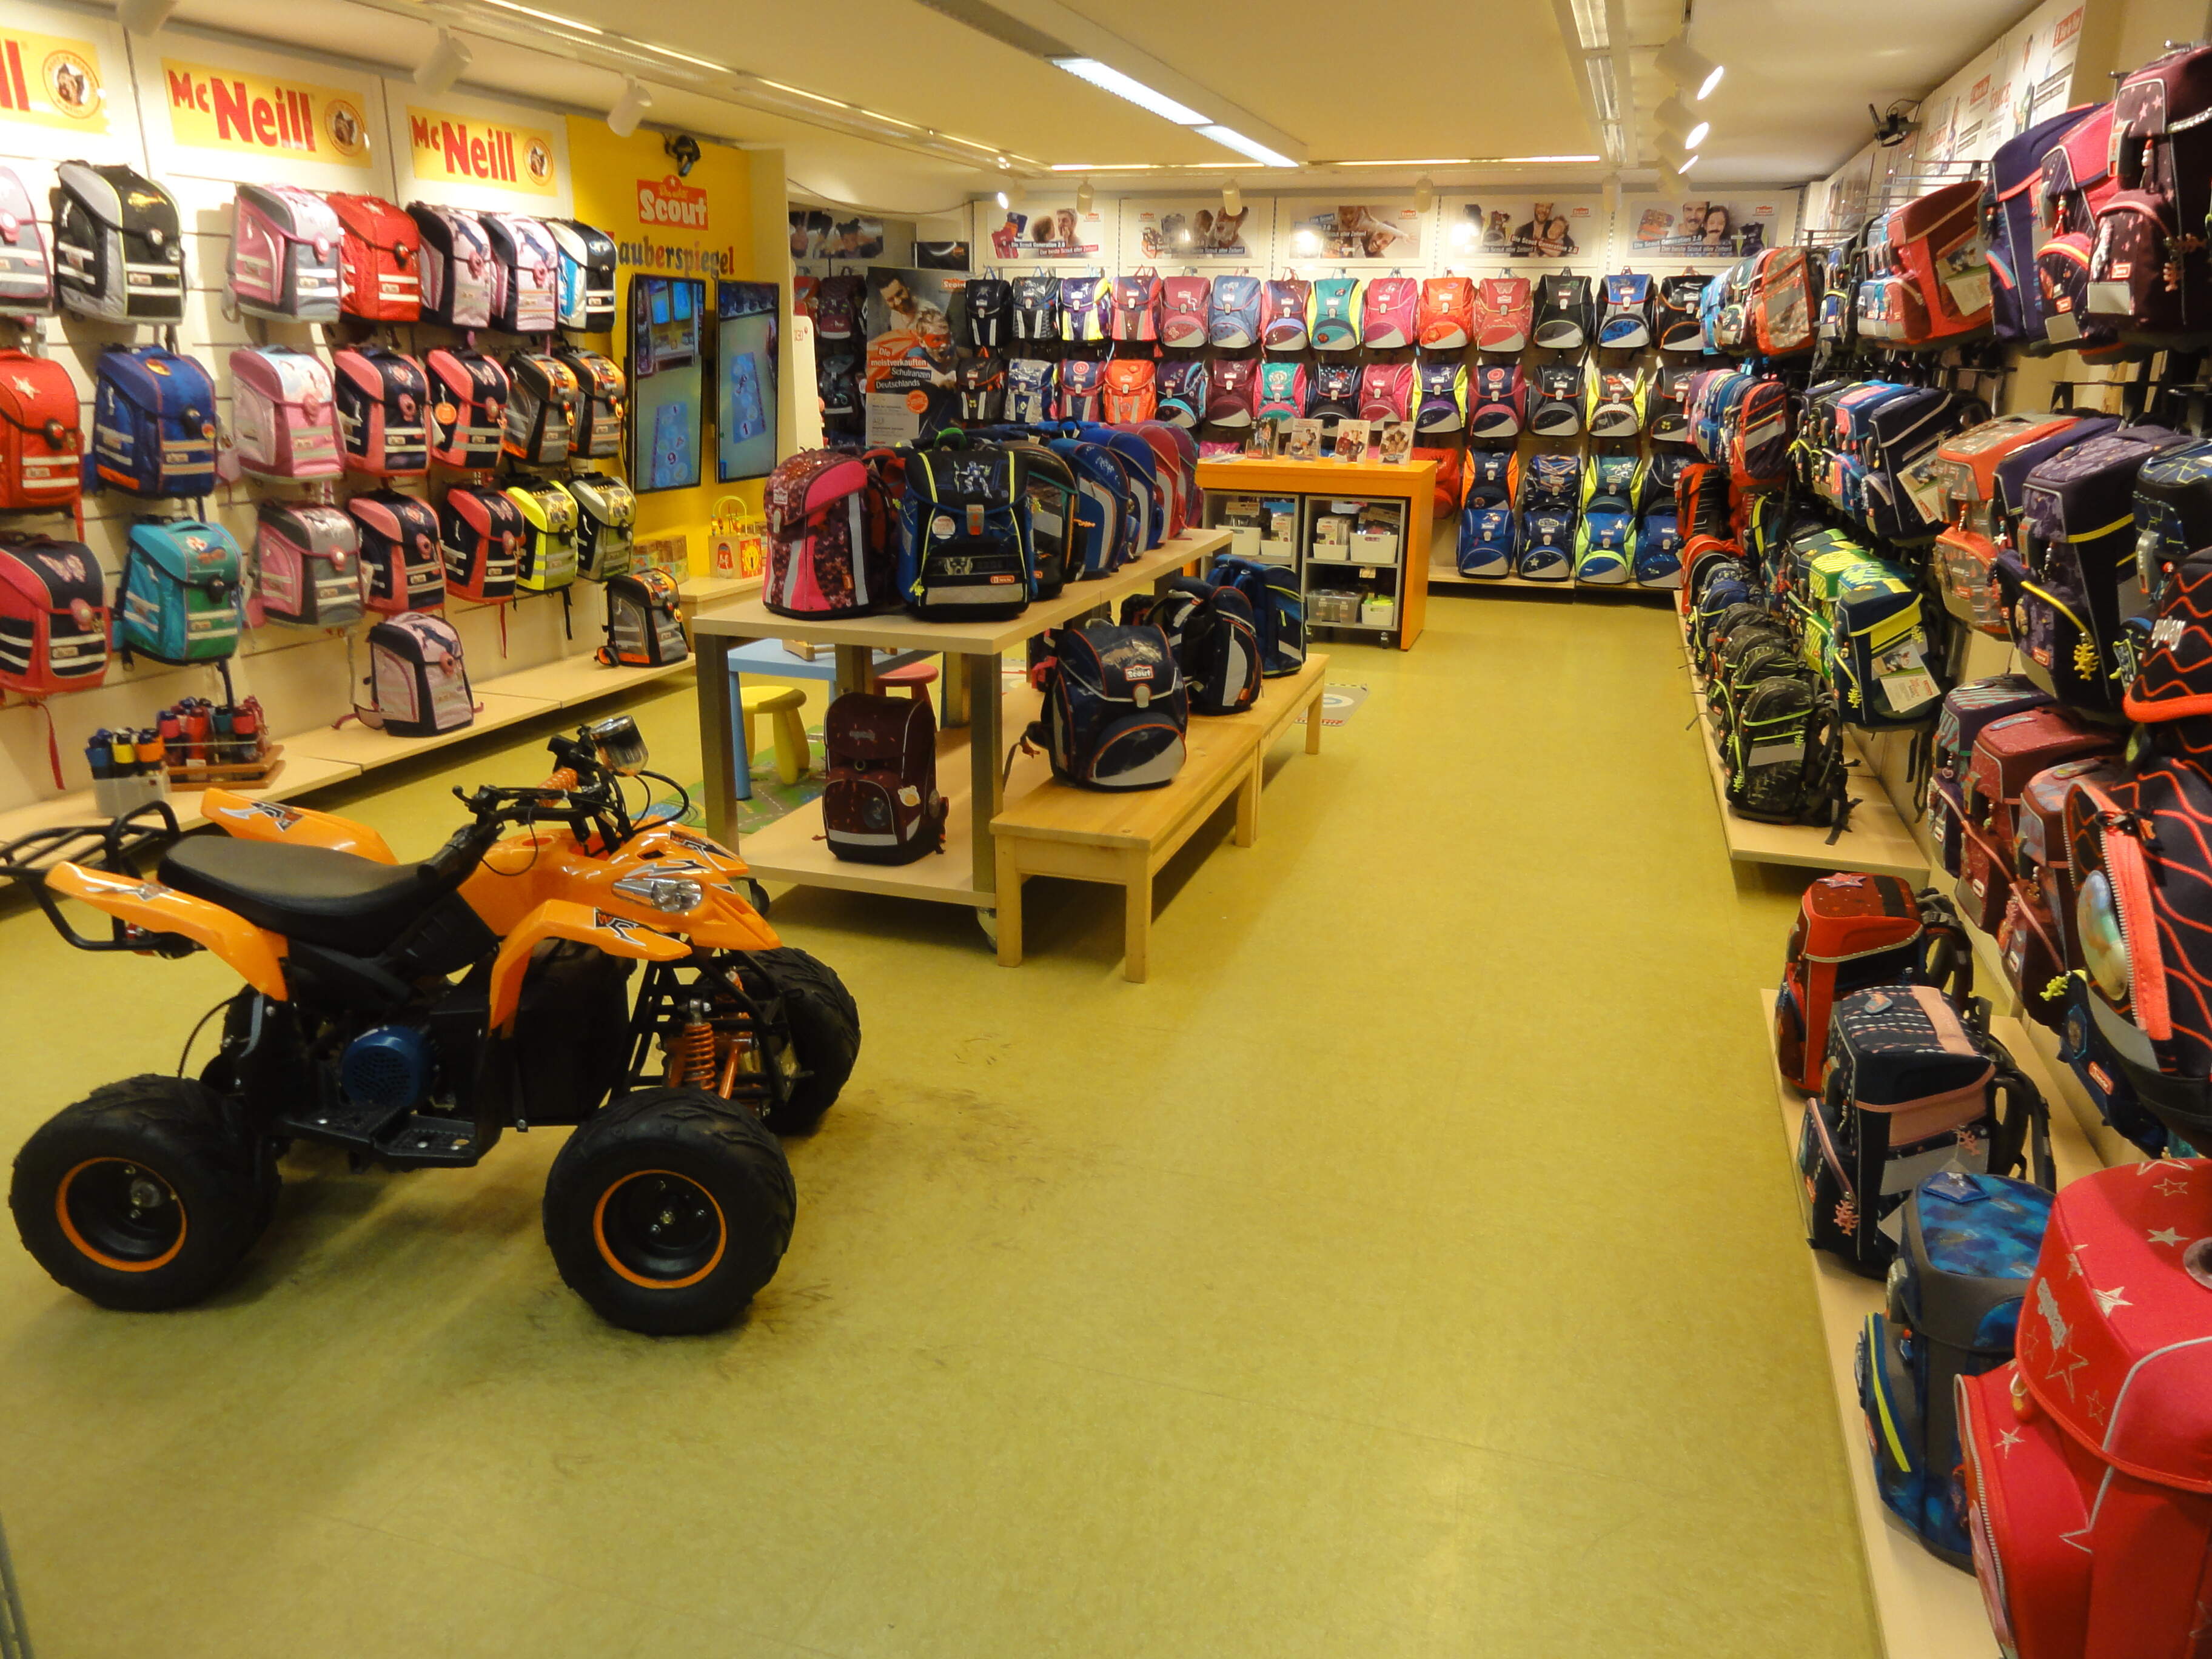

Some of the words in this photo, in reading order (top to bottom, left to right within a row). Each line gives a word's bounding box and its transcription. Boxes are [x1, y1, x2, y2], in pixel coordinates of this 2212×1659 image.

[168, 69, 317, 153] McNeill
[411, 115, 517, 183] McNeill
[640, 189, 707, 226] Scout
[605, 230, 735, 280] auberspiegel
[879, 348, 891, 357] Die
[876, 380, 920, 389] Deutschlands
[891, 368, 930, 379] Schulranzen
[1127, 669, 1150, 678] Scout
